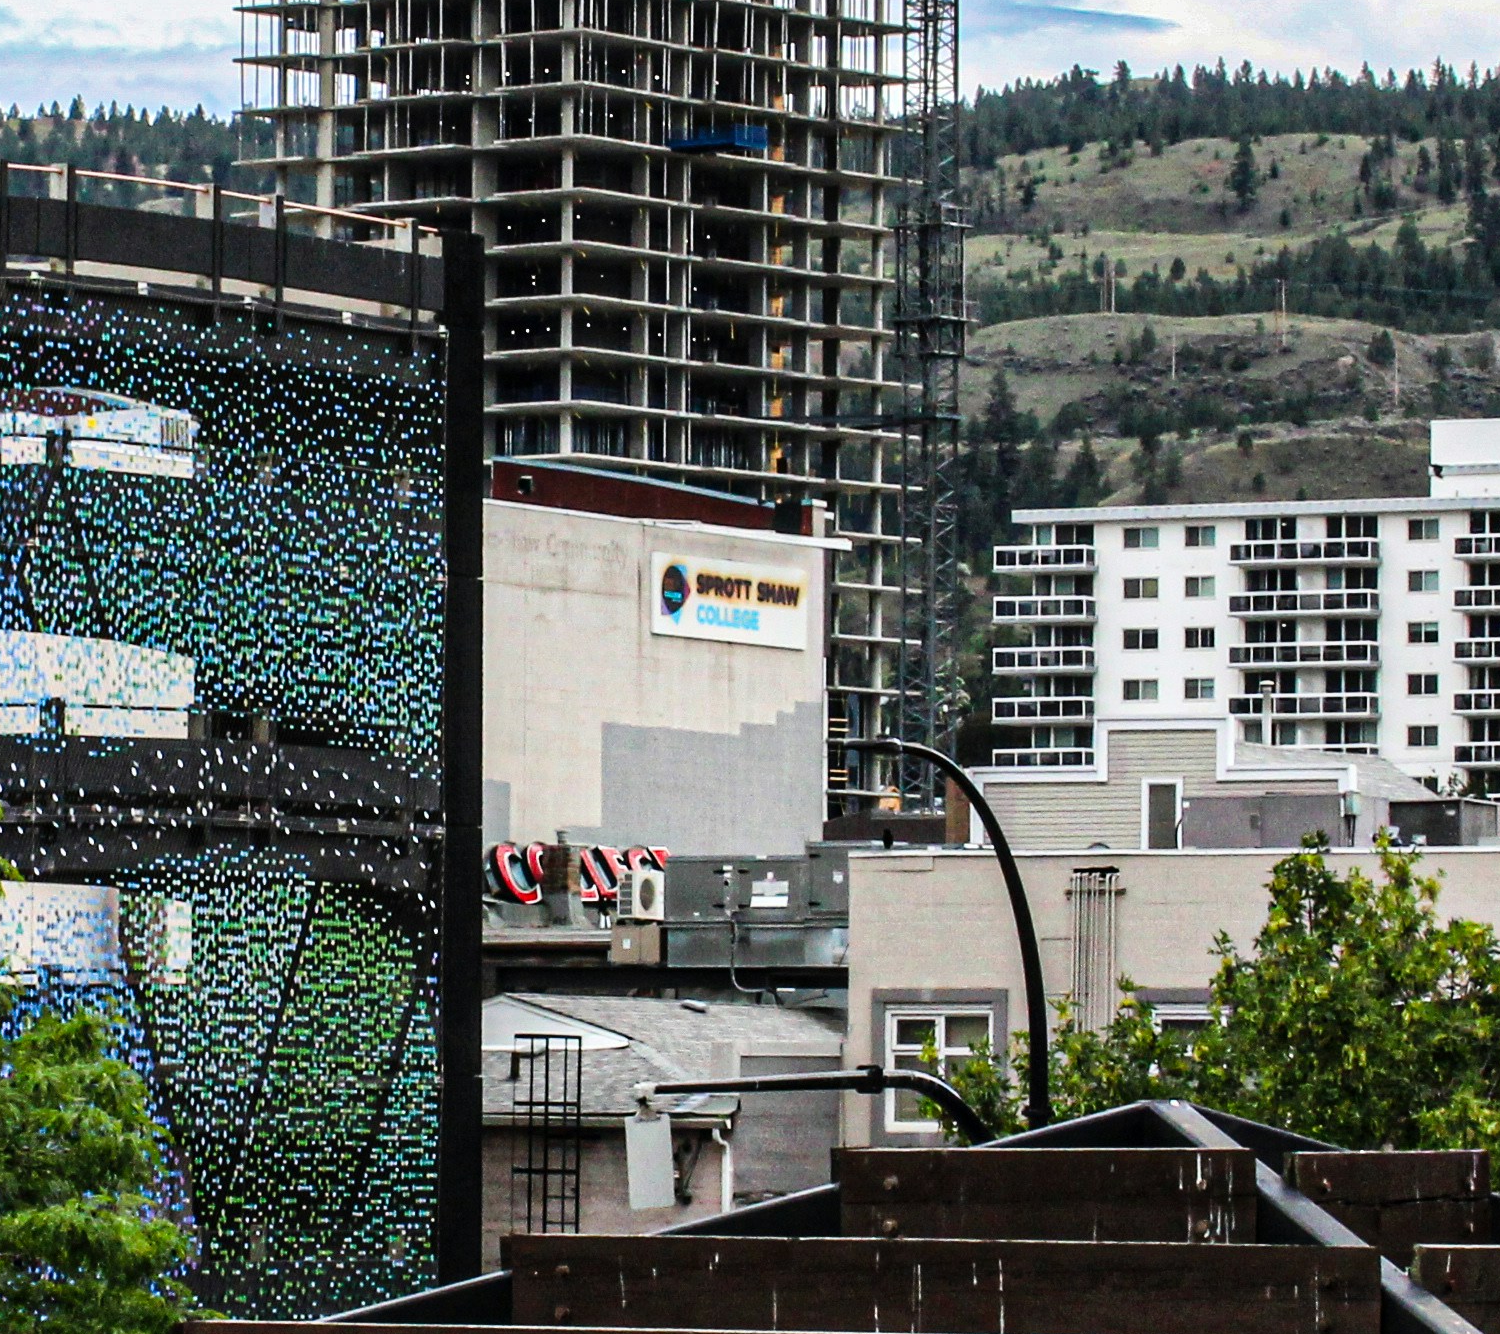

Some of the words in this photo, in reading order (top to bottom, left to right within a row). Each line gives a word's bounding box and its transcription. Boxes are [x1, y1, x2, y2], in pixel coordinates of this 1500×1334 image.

[696, 574, 752, 601] SPROTT
[757, 581, 800, 607] SHAW
[696, 604, 760, 631] COLLEGE
